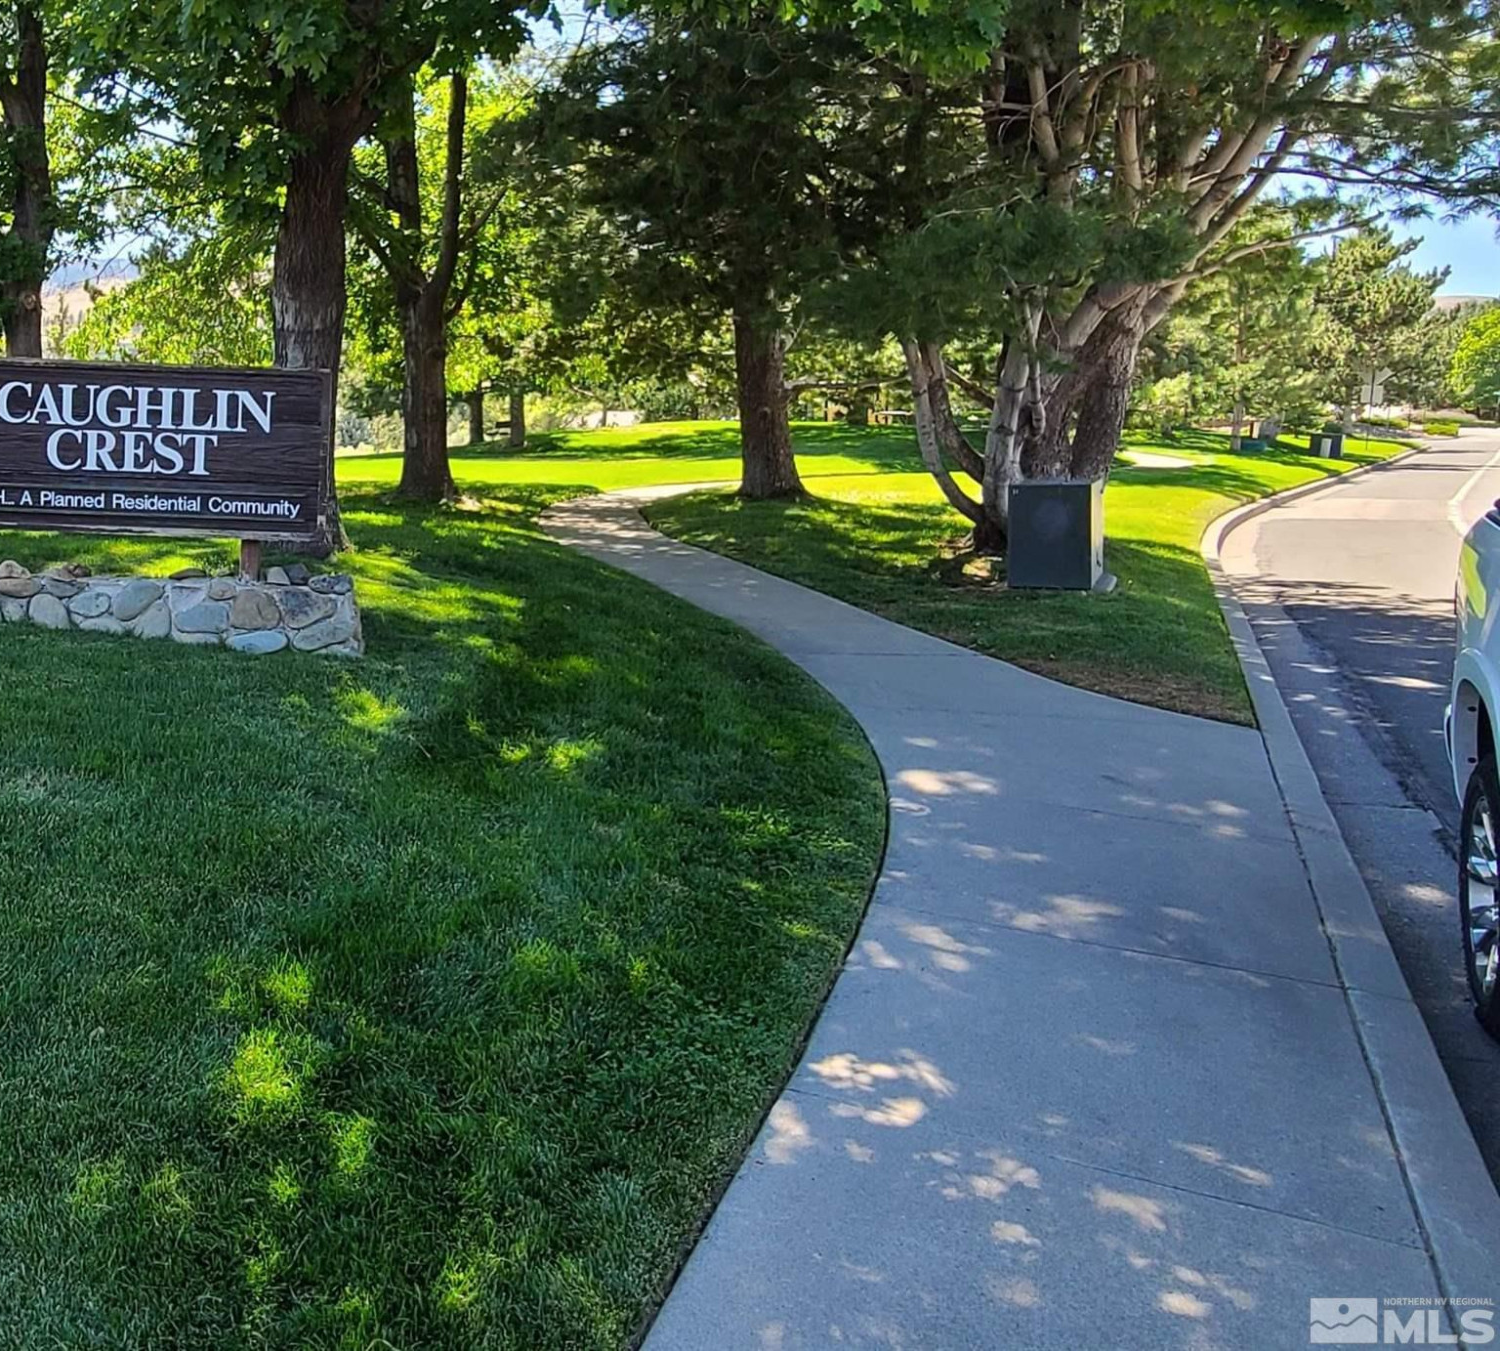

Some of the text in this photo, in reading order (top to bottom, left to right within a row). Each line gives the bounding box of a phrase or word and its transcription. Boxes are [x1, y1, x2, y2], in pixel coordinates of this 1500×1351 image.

[47, 428, 218, 475] CREST
[20, 491, 33, 506] A
[40, 491, 104, 508] Planned
[112, 494, 201, 512] Residential
[208, 497, 300, 518] Community
